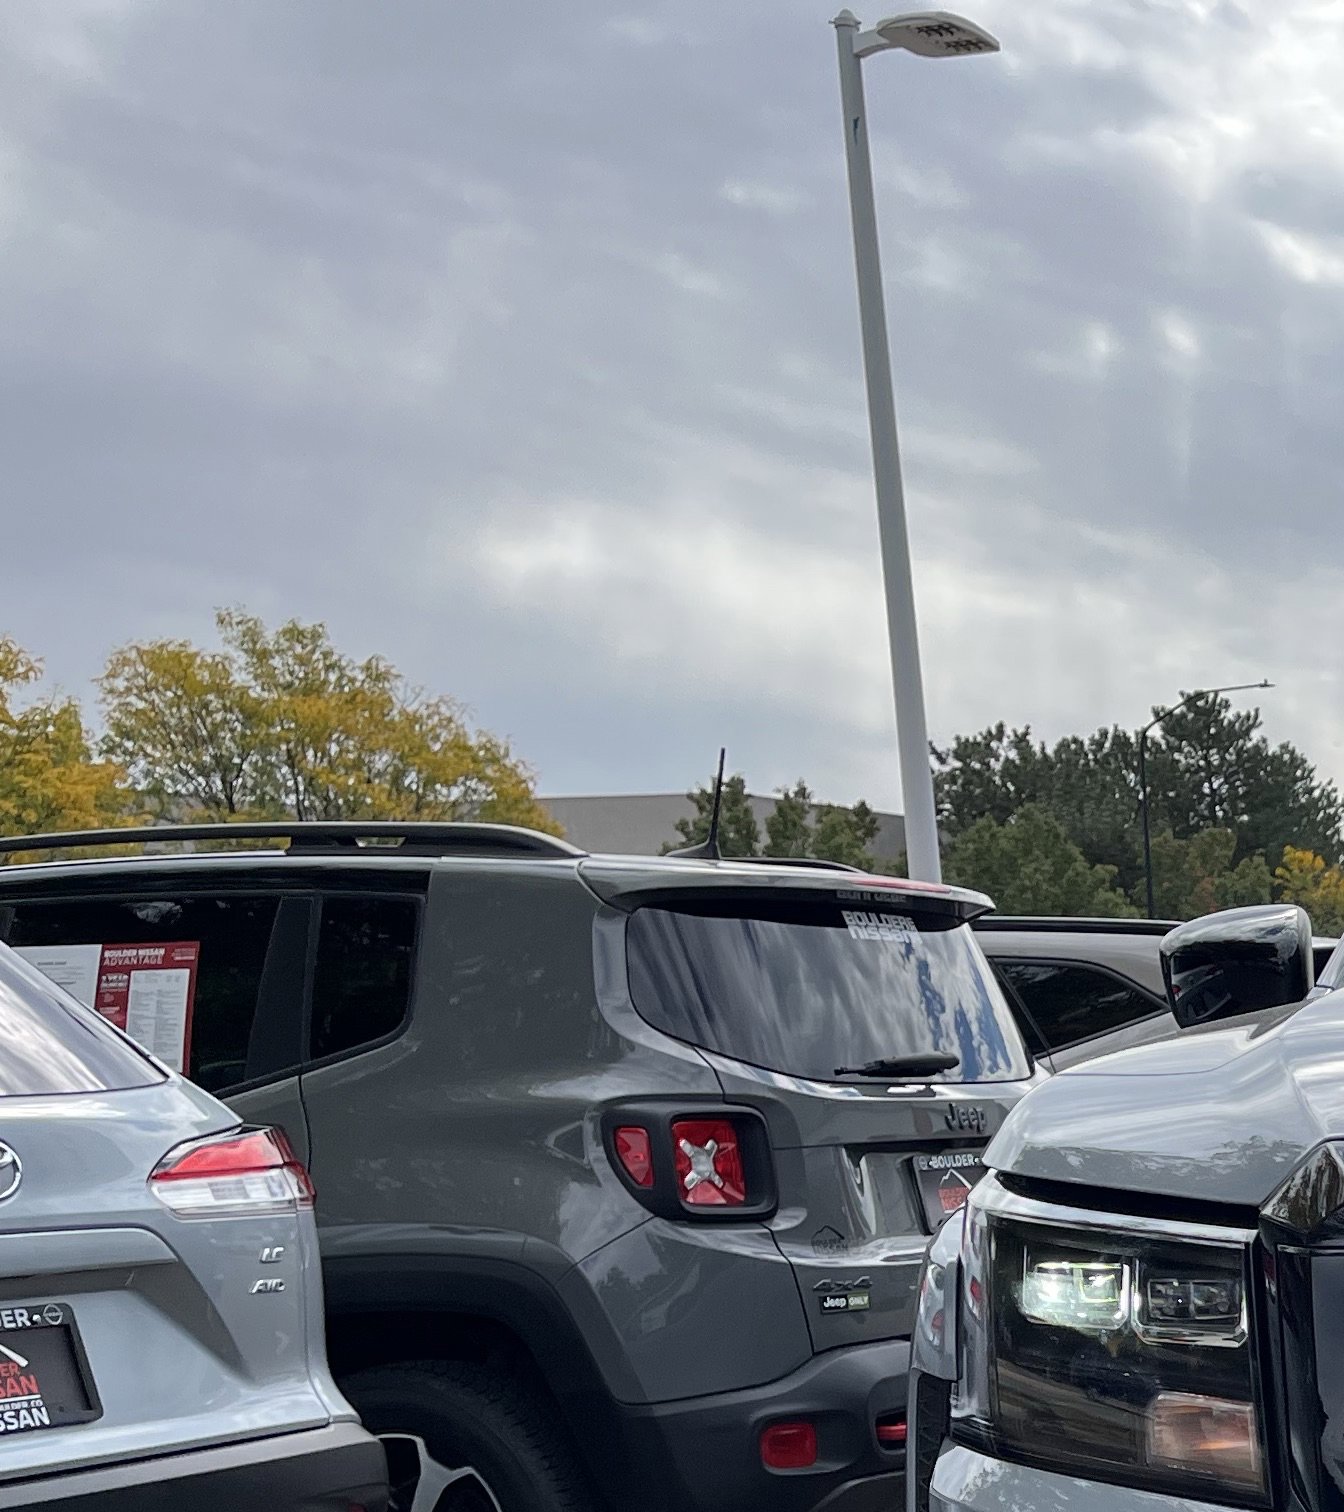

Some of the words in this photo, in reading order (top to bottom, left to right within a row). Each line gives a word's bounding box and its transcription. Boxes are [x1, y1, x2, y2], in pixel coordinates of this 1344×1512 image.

[103, 954, 164, 967] ADVANTAGE
[944, 1102, 987, 1134] Jeep
[931, 1154, 974, 1168] BOULDER
[824, 1296, 847, 1308] Jeep
[0, 1308, 31, 1328] ER
